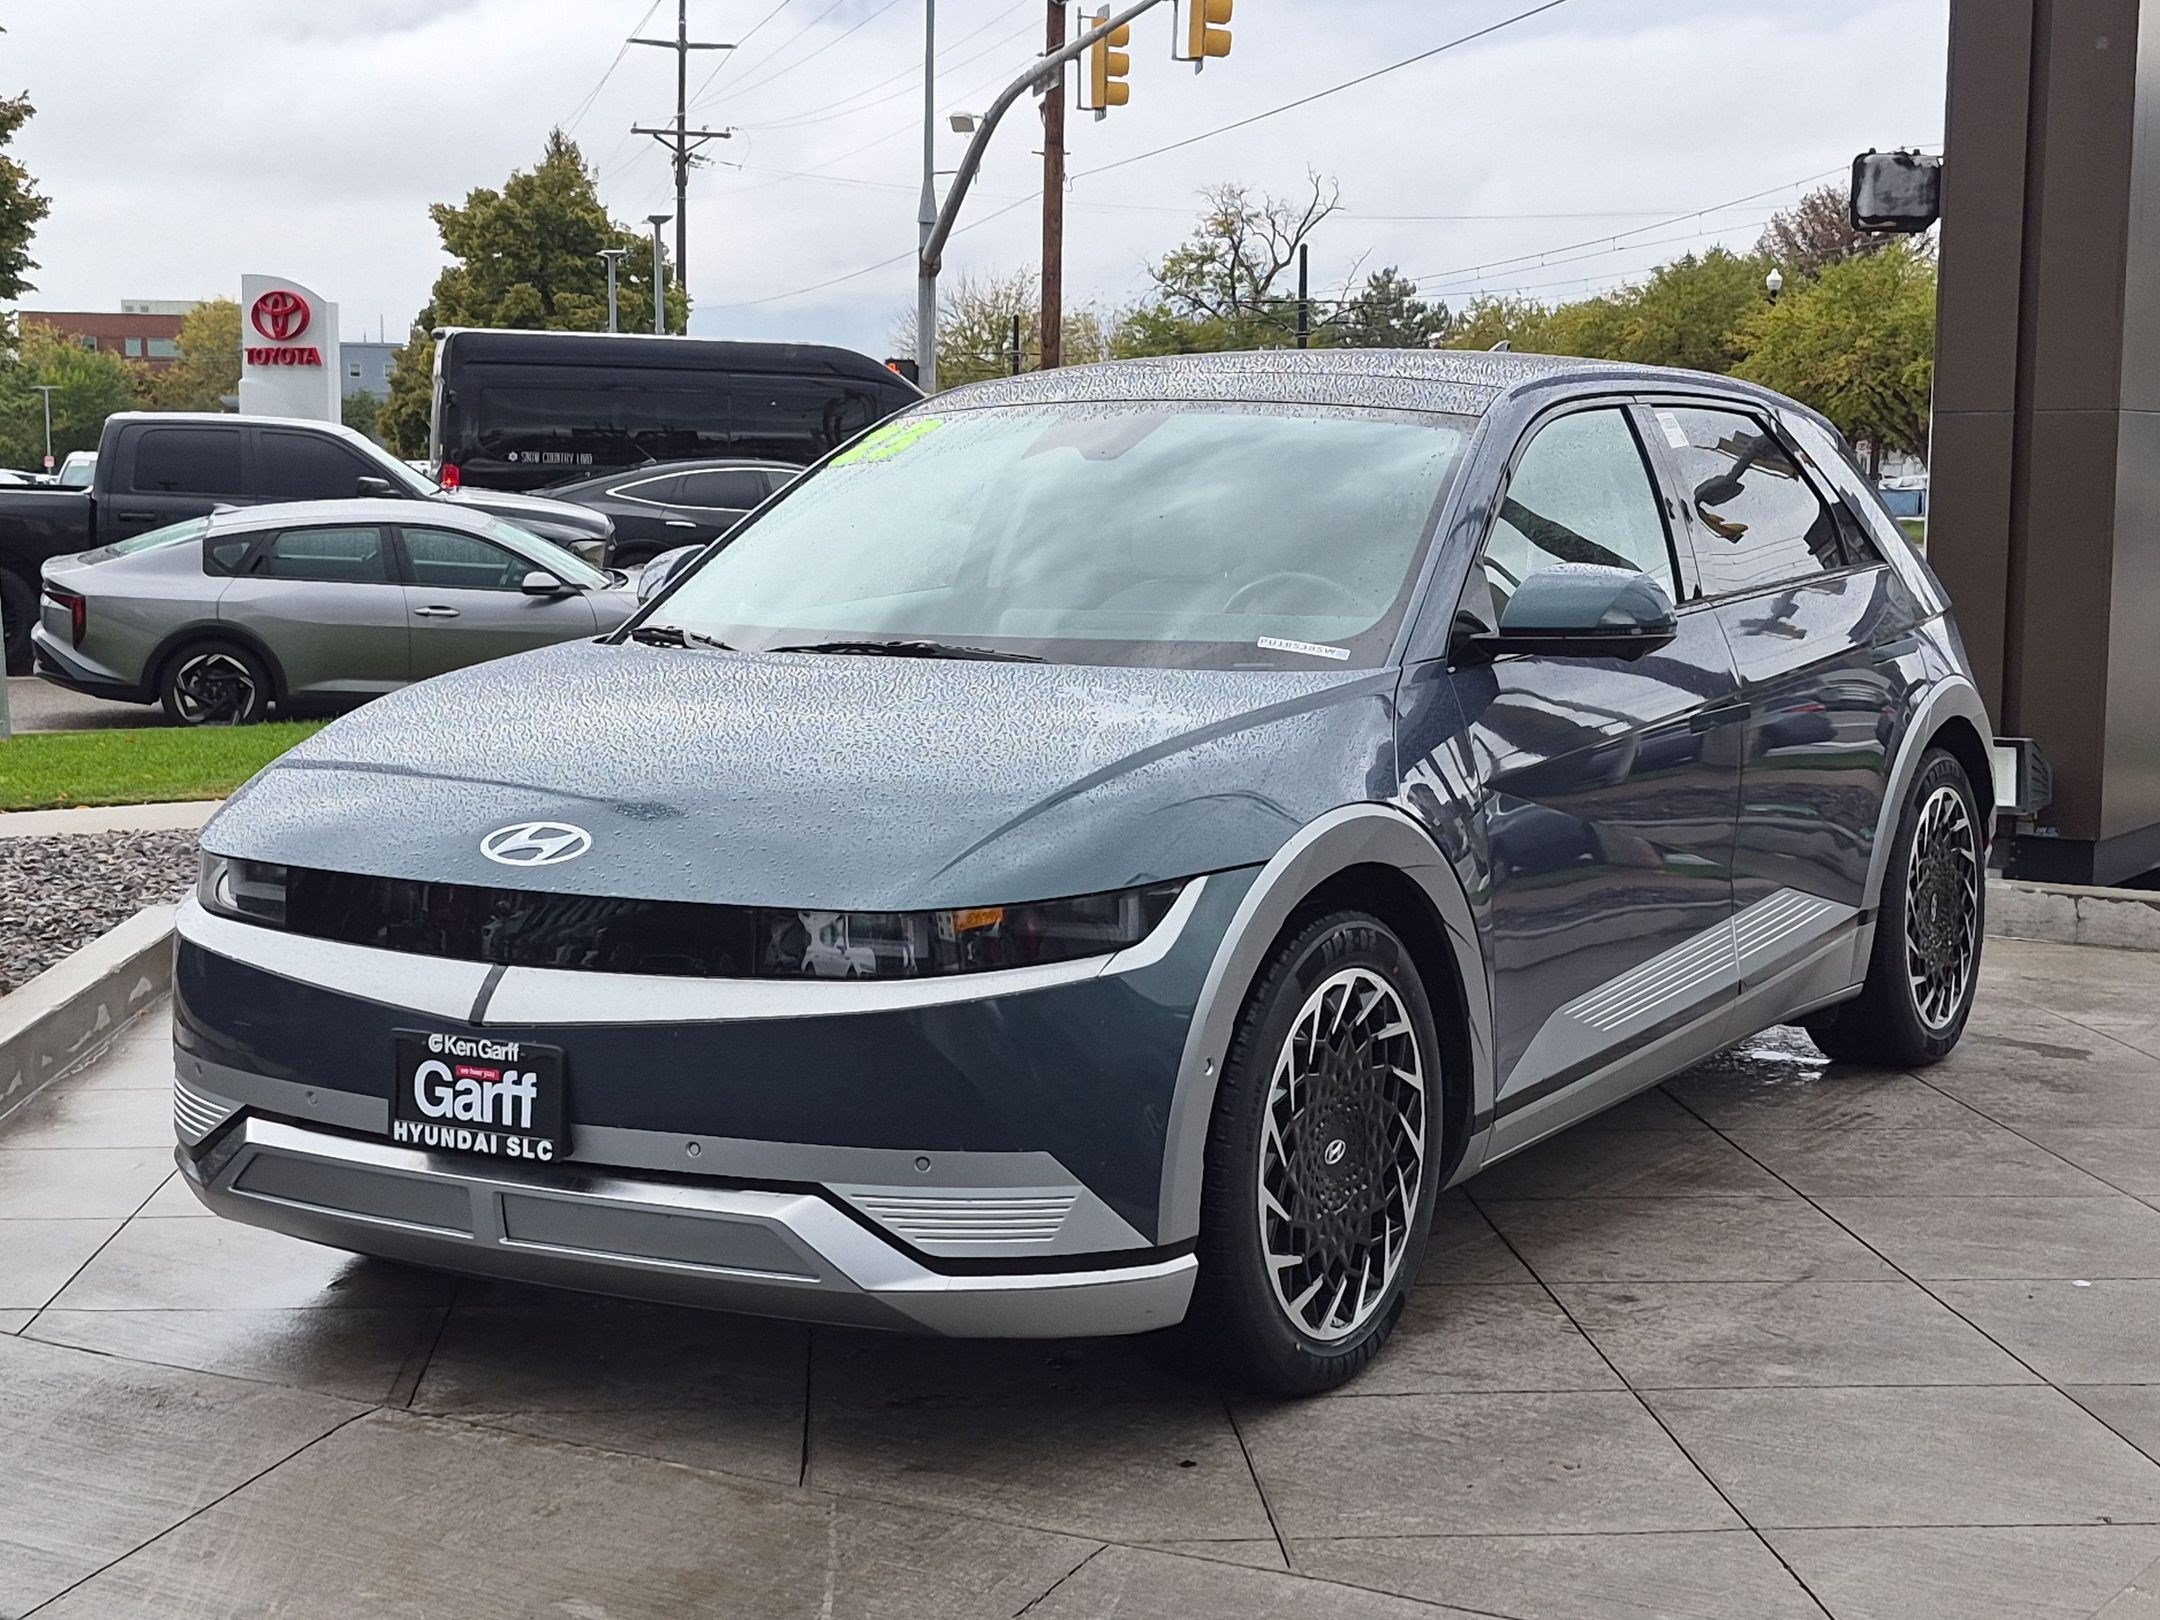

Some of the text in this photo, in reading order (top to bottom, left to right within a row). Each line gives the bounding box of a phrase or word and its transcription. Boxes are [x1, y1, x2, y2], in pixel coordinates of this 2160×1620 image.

[244, 346, 322, 367] TOYOTA
[444, 1035, 520, 1062] Ken Garff
[414, 1059, 538, 1129] Garff
[393, 1120, 554, 1162] HYUNDAI SLC
